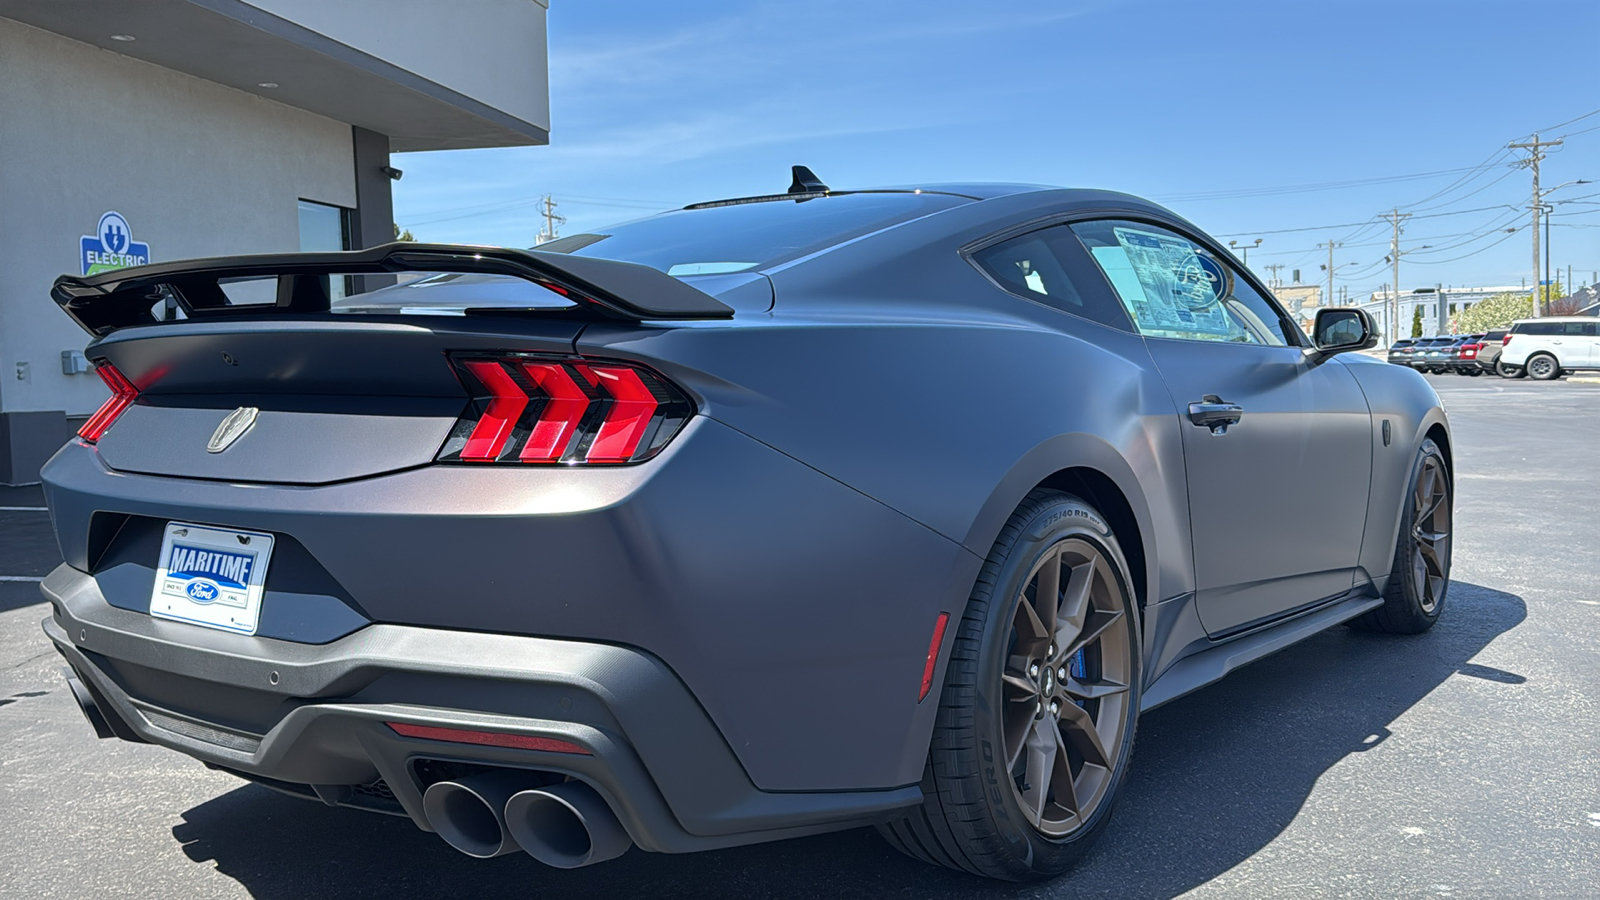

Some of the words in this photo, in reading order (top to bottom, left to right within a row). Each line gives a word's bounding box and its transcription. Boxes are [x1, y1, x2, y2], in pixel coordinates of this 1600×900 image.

[86, 250, 145, 267] ELECTRIC
[169, 547, 252, 588] MARITIME
[190, 582, 215, 600] Ford
